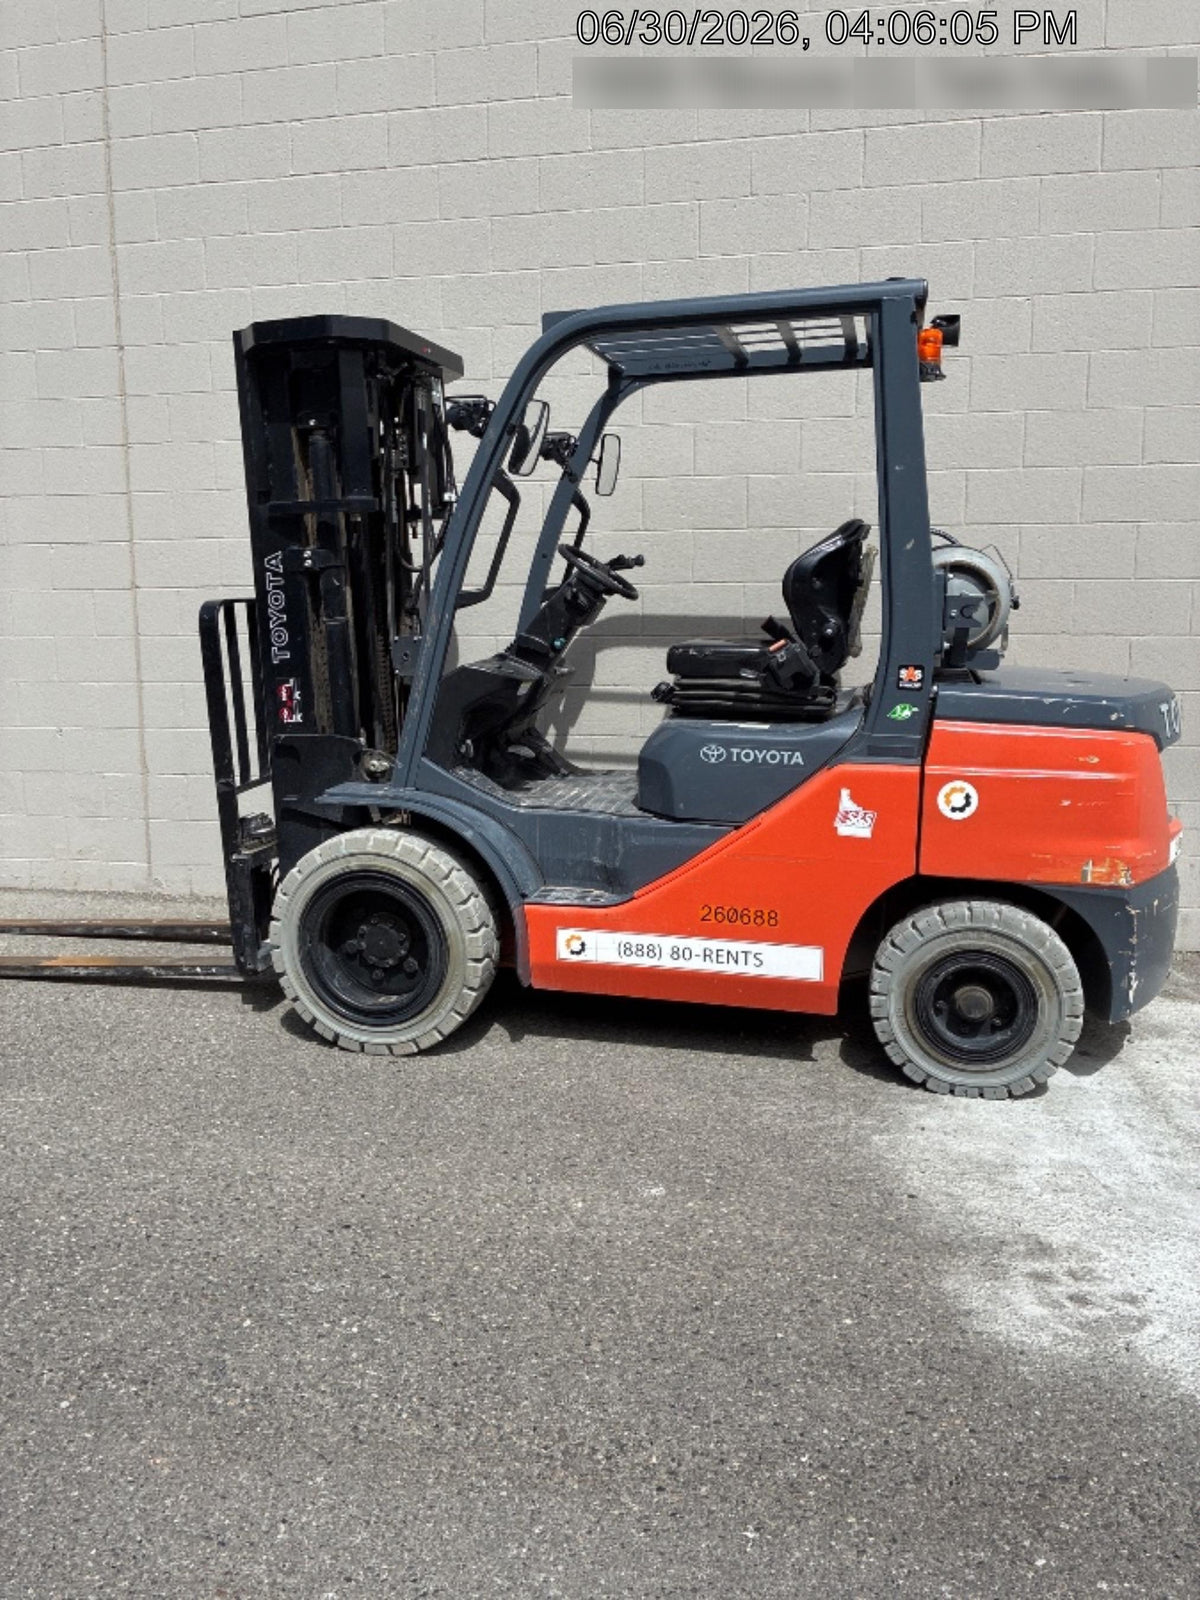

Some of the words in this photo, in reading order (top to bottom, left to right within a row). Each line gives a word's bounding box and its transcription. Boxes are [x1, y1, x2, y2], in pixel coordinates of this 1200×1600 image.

[264, 551, 290, 664] TOYOTA
[730, 748, 804, 765] TOYOTA
[700, 904, 779, 928] 260688
[617, 941, 663, 960] (888)
[669, 945, 764, 968] 80-RENTS
